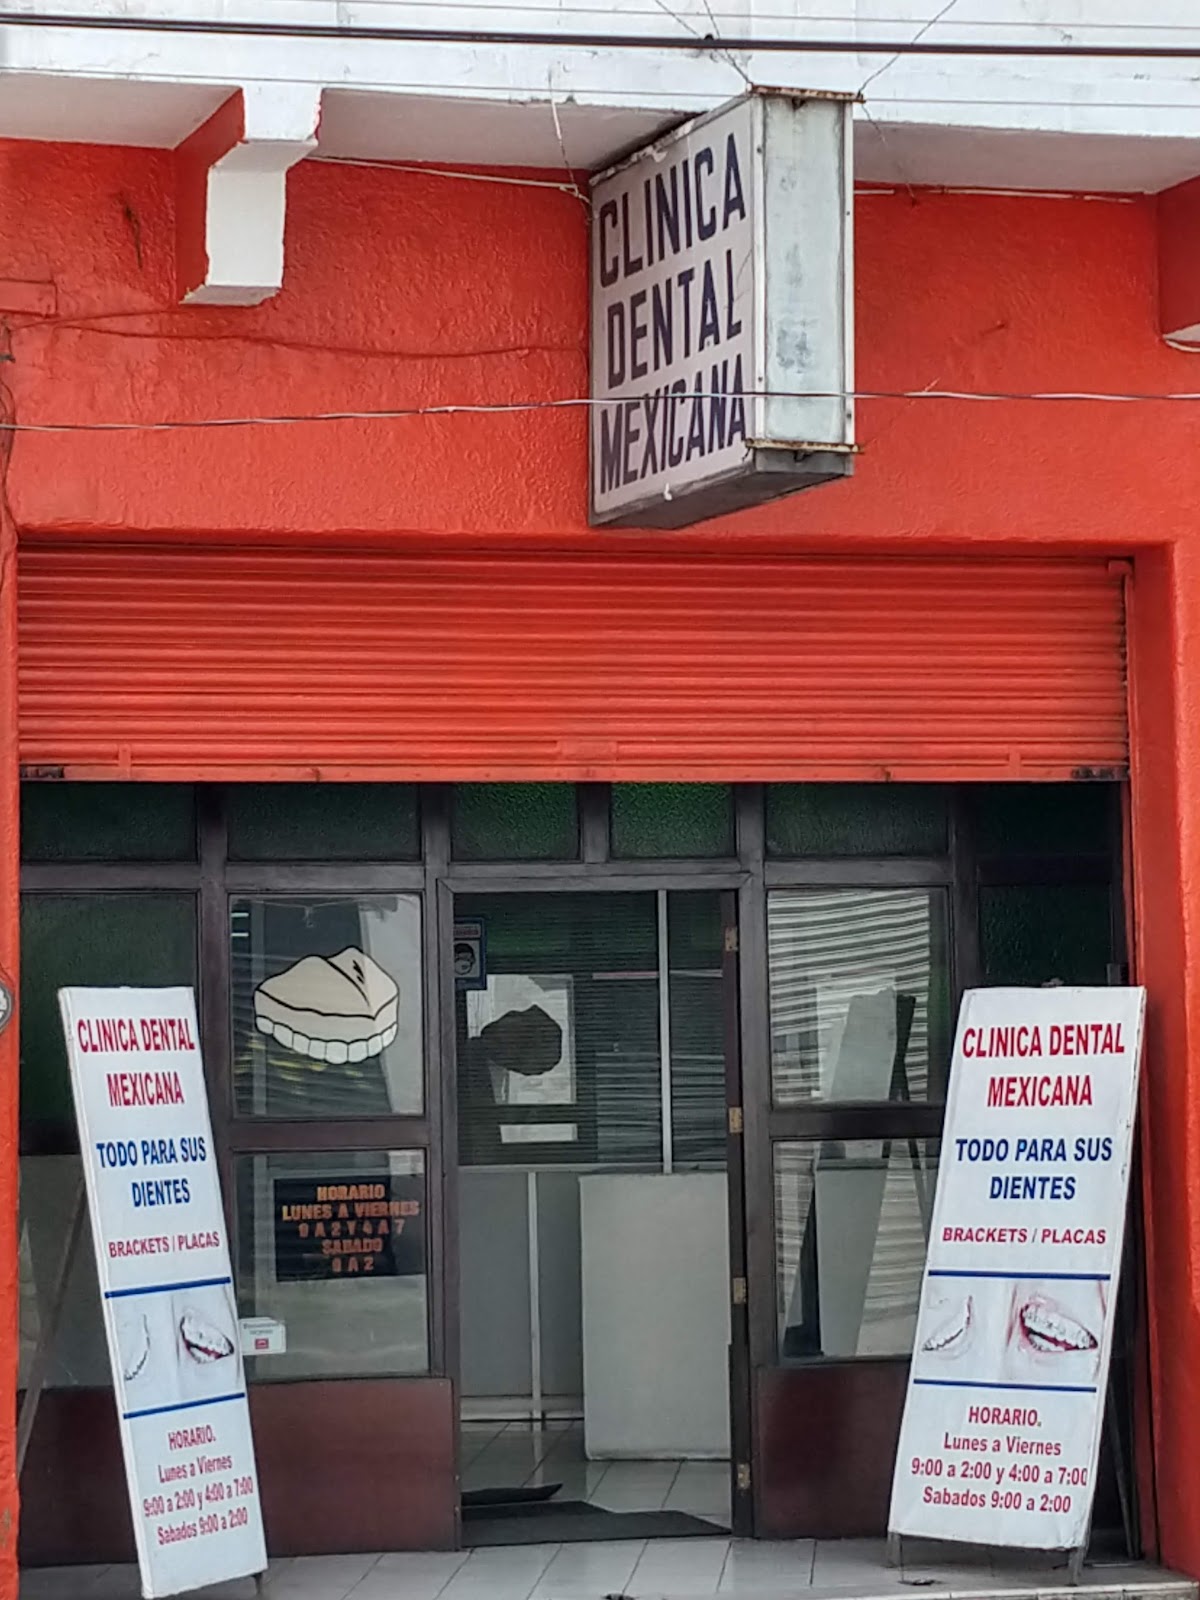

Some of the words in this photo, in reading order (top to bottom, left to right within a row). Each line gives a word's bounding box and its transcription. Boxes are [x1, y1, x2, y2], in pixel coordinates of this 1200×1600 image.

[599, 133, 747, 288] CLINICA
[606, 249, 743, 390] DENTAL
[600, 353, 747, 494] MEXICANA
[77, 1018, 142, 1053] CLINICA
[140, 1018, 196, 1051] DENTAL
[962, 1026, 1042, 1058] CLINICA
[1049, 1023, 1125, 1055] DENTAL
[106, 1072, 185, 1107] MEXICANA
[987, 1075, 1093, 1107] MEXICANA
[96, 1142, 138, 1168] TODO
[142, 1139, 179, 1165] PARA
[181, 1137, 207, 1163] SUS
[956, 1138, 1009, 1162] TODO
[1014, 1138, 1067, 1162] PARA
[1073, 1137, 1113, 1162] SUS
[131, 1178, 191, 1208] DIENTES
[317, 1185, 385, 1200] HORARIO
[989, 1176, 1076, 1200] DIENTES
[282, 1204, 332, 1220] LUNES
[338, 1204, 348, 1217] A
[355, 1201, 419, 1217] VIERNES
[108, 1236, 170, 1258] BRACKETS
[177, 1231, 220, 1251] PLACAS
[942, 1227, 1028, 1244] BRACKETS
[1040, 1228, 1107, 1245] PLACAS
[968, 1405, 1042, 1428] HORARIO.
[168, 1424, 216, 1451] HORARIO.
[943, 1432, 988, 1452] Lunes
[992, 1439, 1001, 1453] a
[1006, 1435, 1062, 1456] Viernes
[158, 1464, 187, 1483] Lunes
[189, 1462, 196, 1477] a
[196, 1455, 232, 1475] Viernes
[911, 1457, 943, 1477] 9:00
[947, 1464, 956, 1478] a
[960, 1461, 992, 1480] 2:00
[996, 1467, 1005, 1485] y
[1008, 1464, 1040, 1484] 4:00
[1044, 1471, 1053, 1485] a
[1058, 1467, 1087, 1487] 7:00
[143, 1495, 165, 1517] 9:00
[167, 1498, 173, 1513] a
[174, 1487, 195, 1511] 2:00
[197, 1491, 202, 1511] y
[205, 1482, 224, 1503] 4:00
[226, 1484, 232, 1499] a
[233, 1475, 253, 1497] 7:00
[923, 1486, 986, 1508] Sabados
[990, 1491, 1022, 1510] 9:00
[1026, 1497, 1035, 1511] a
[1039, 1494, 1071, 1514] 2:00
[157, 1521, 197, 1545] Sabados
[198, 1513, 218, 1535] 9:00
[220, 1516, 227, 1530] a
[228, 1507, 248, 1528] 2:00
